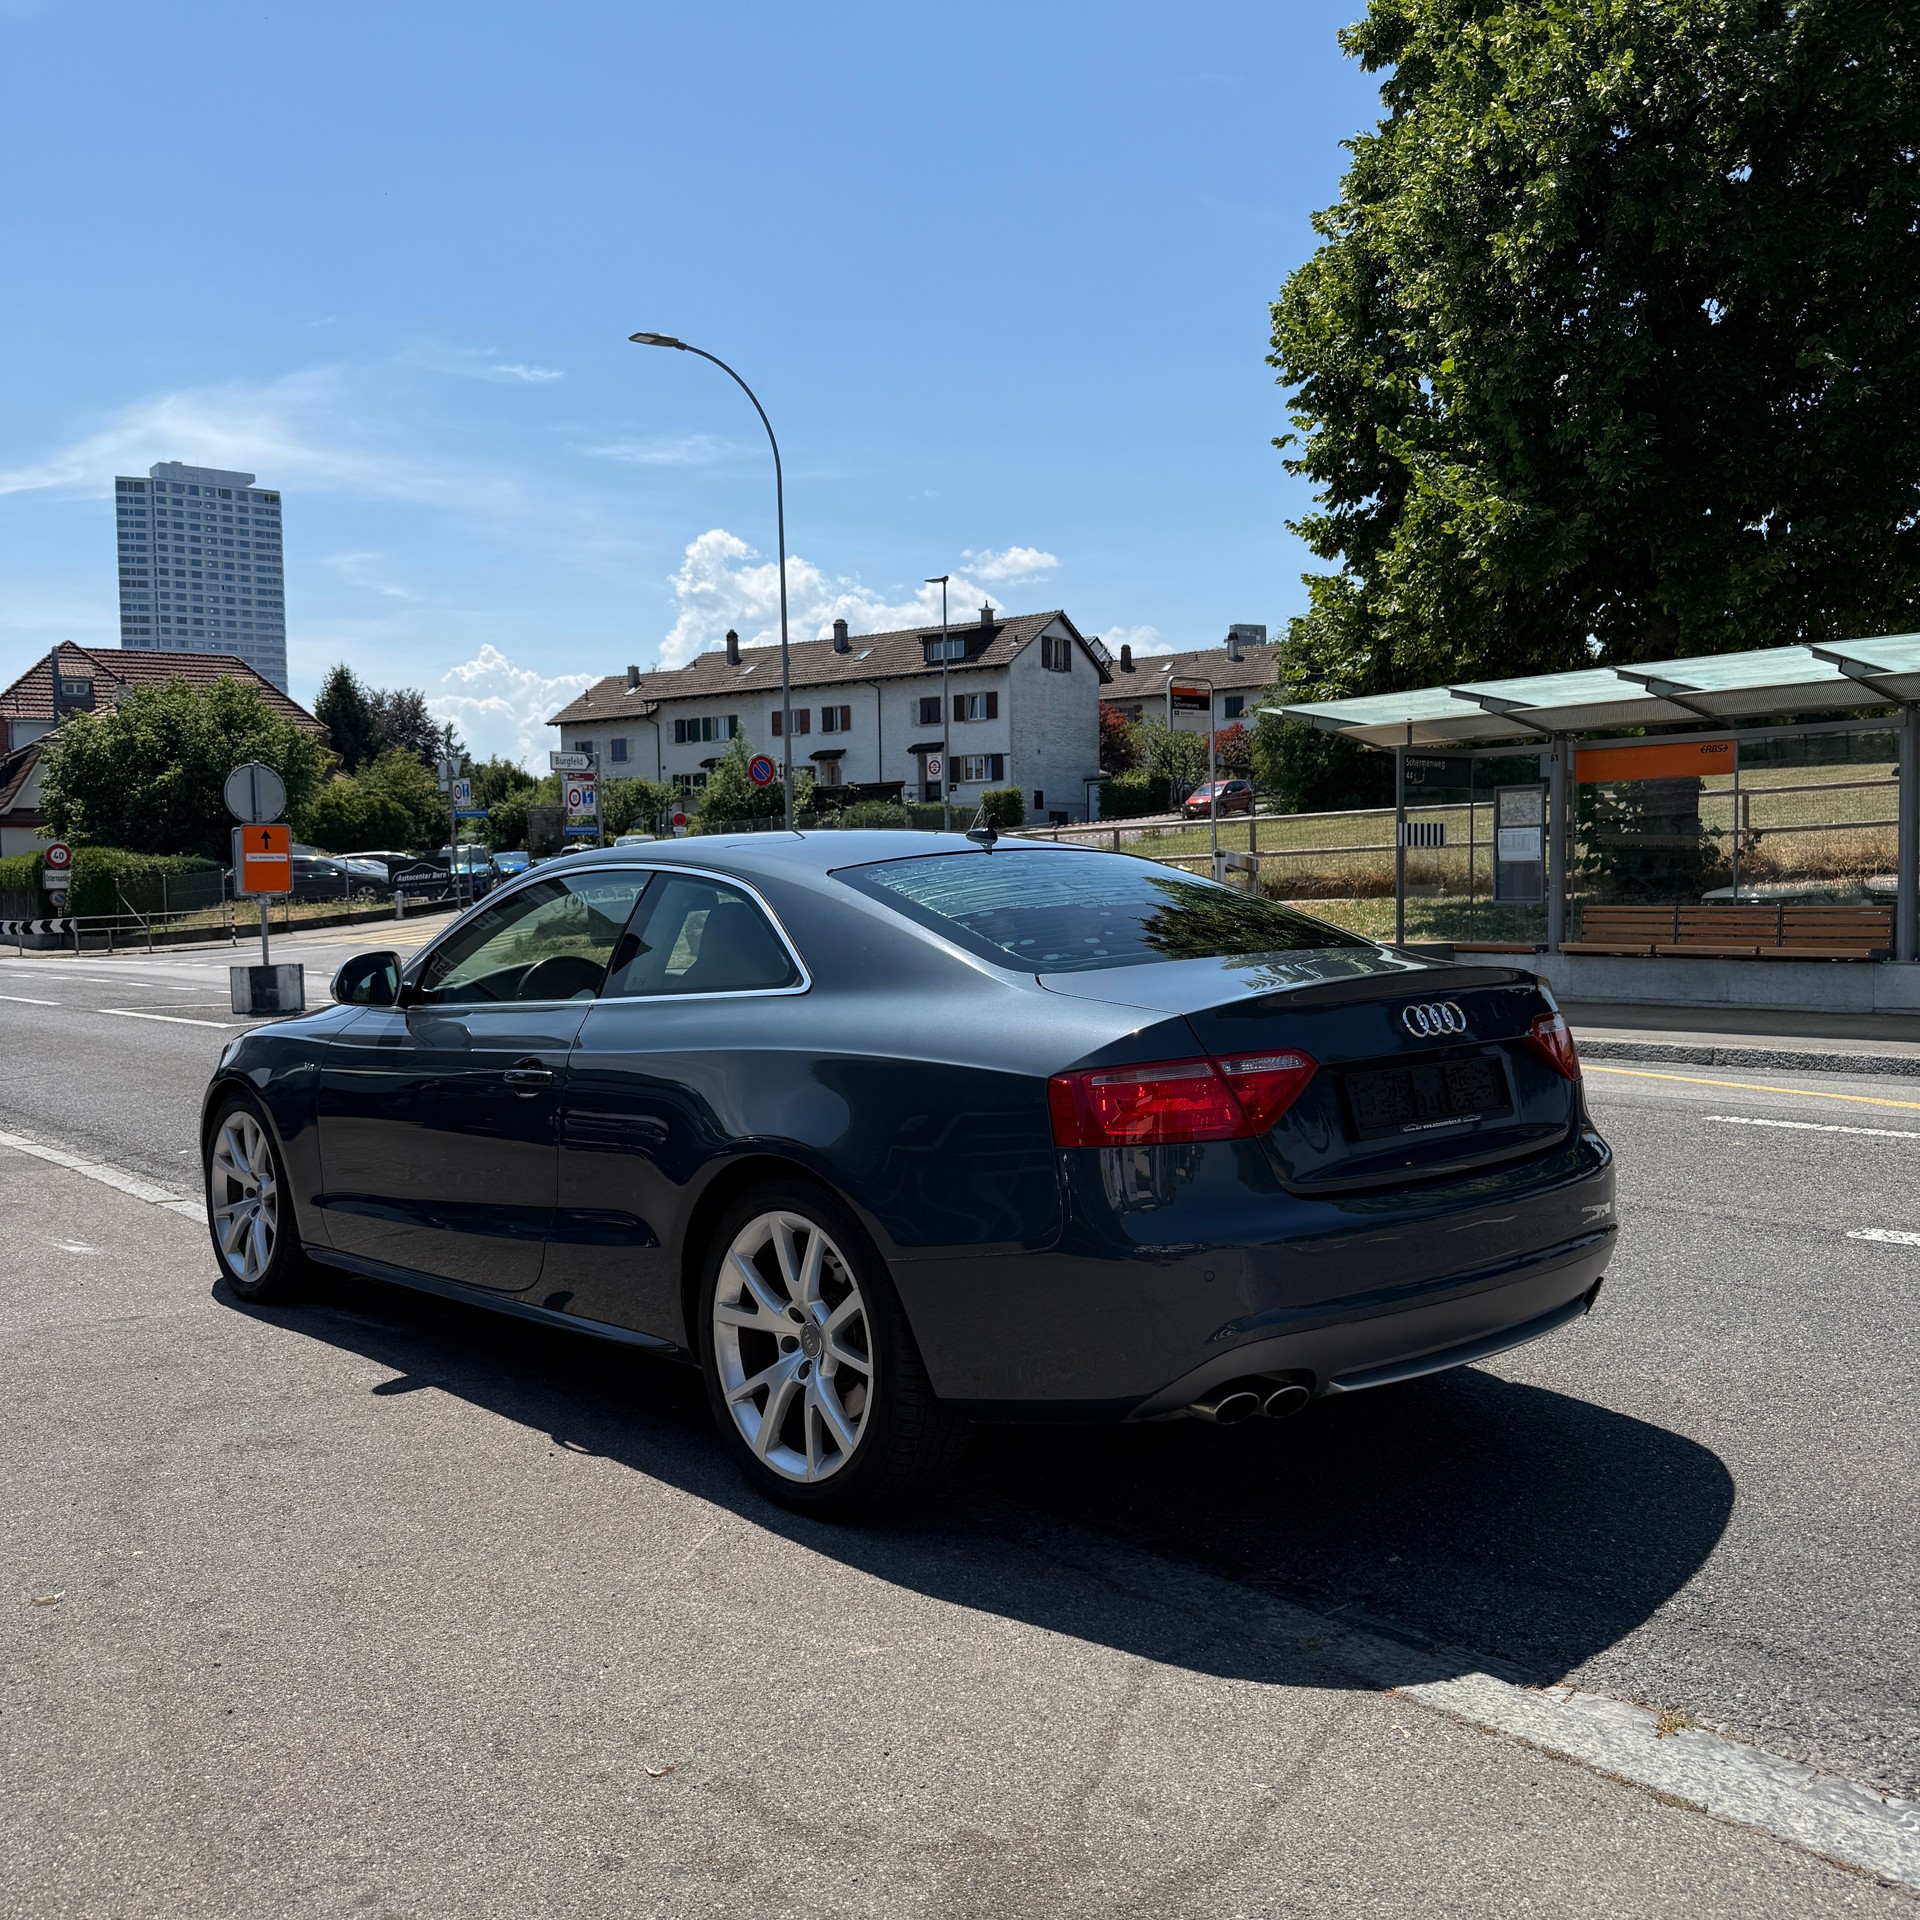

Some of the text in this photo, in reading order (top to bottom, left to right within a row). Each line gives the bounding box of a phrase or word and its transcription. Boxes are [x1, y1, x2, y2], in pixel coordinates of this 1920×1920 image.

[555, 756, 584, 767] Burgfeld
[1405, 757, 1446, 770] Schermenweg
[54, 851, 64, 860] 40
[397, 871, 447, 882] Autocenter Bern
